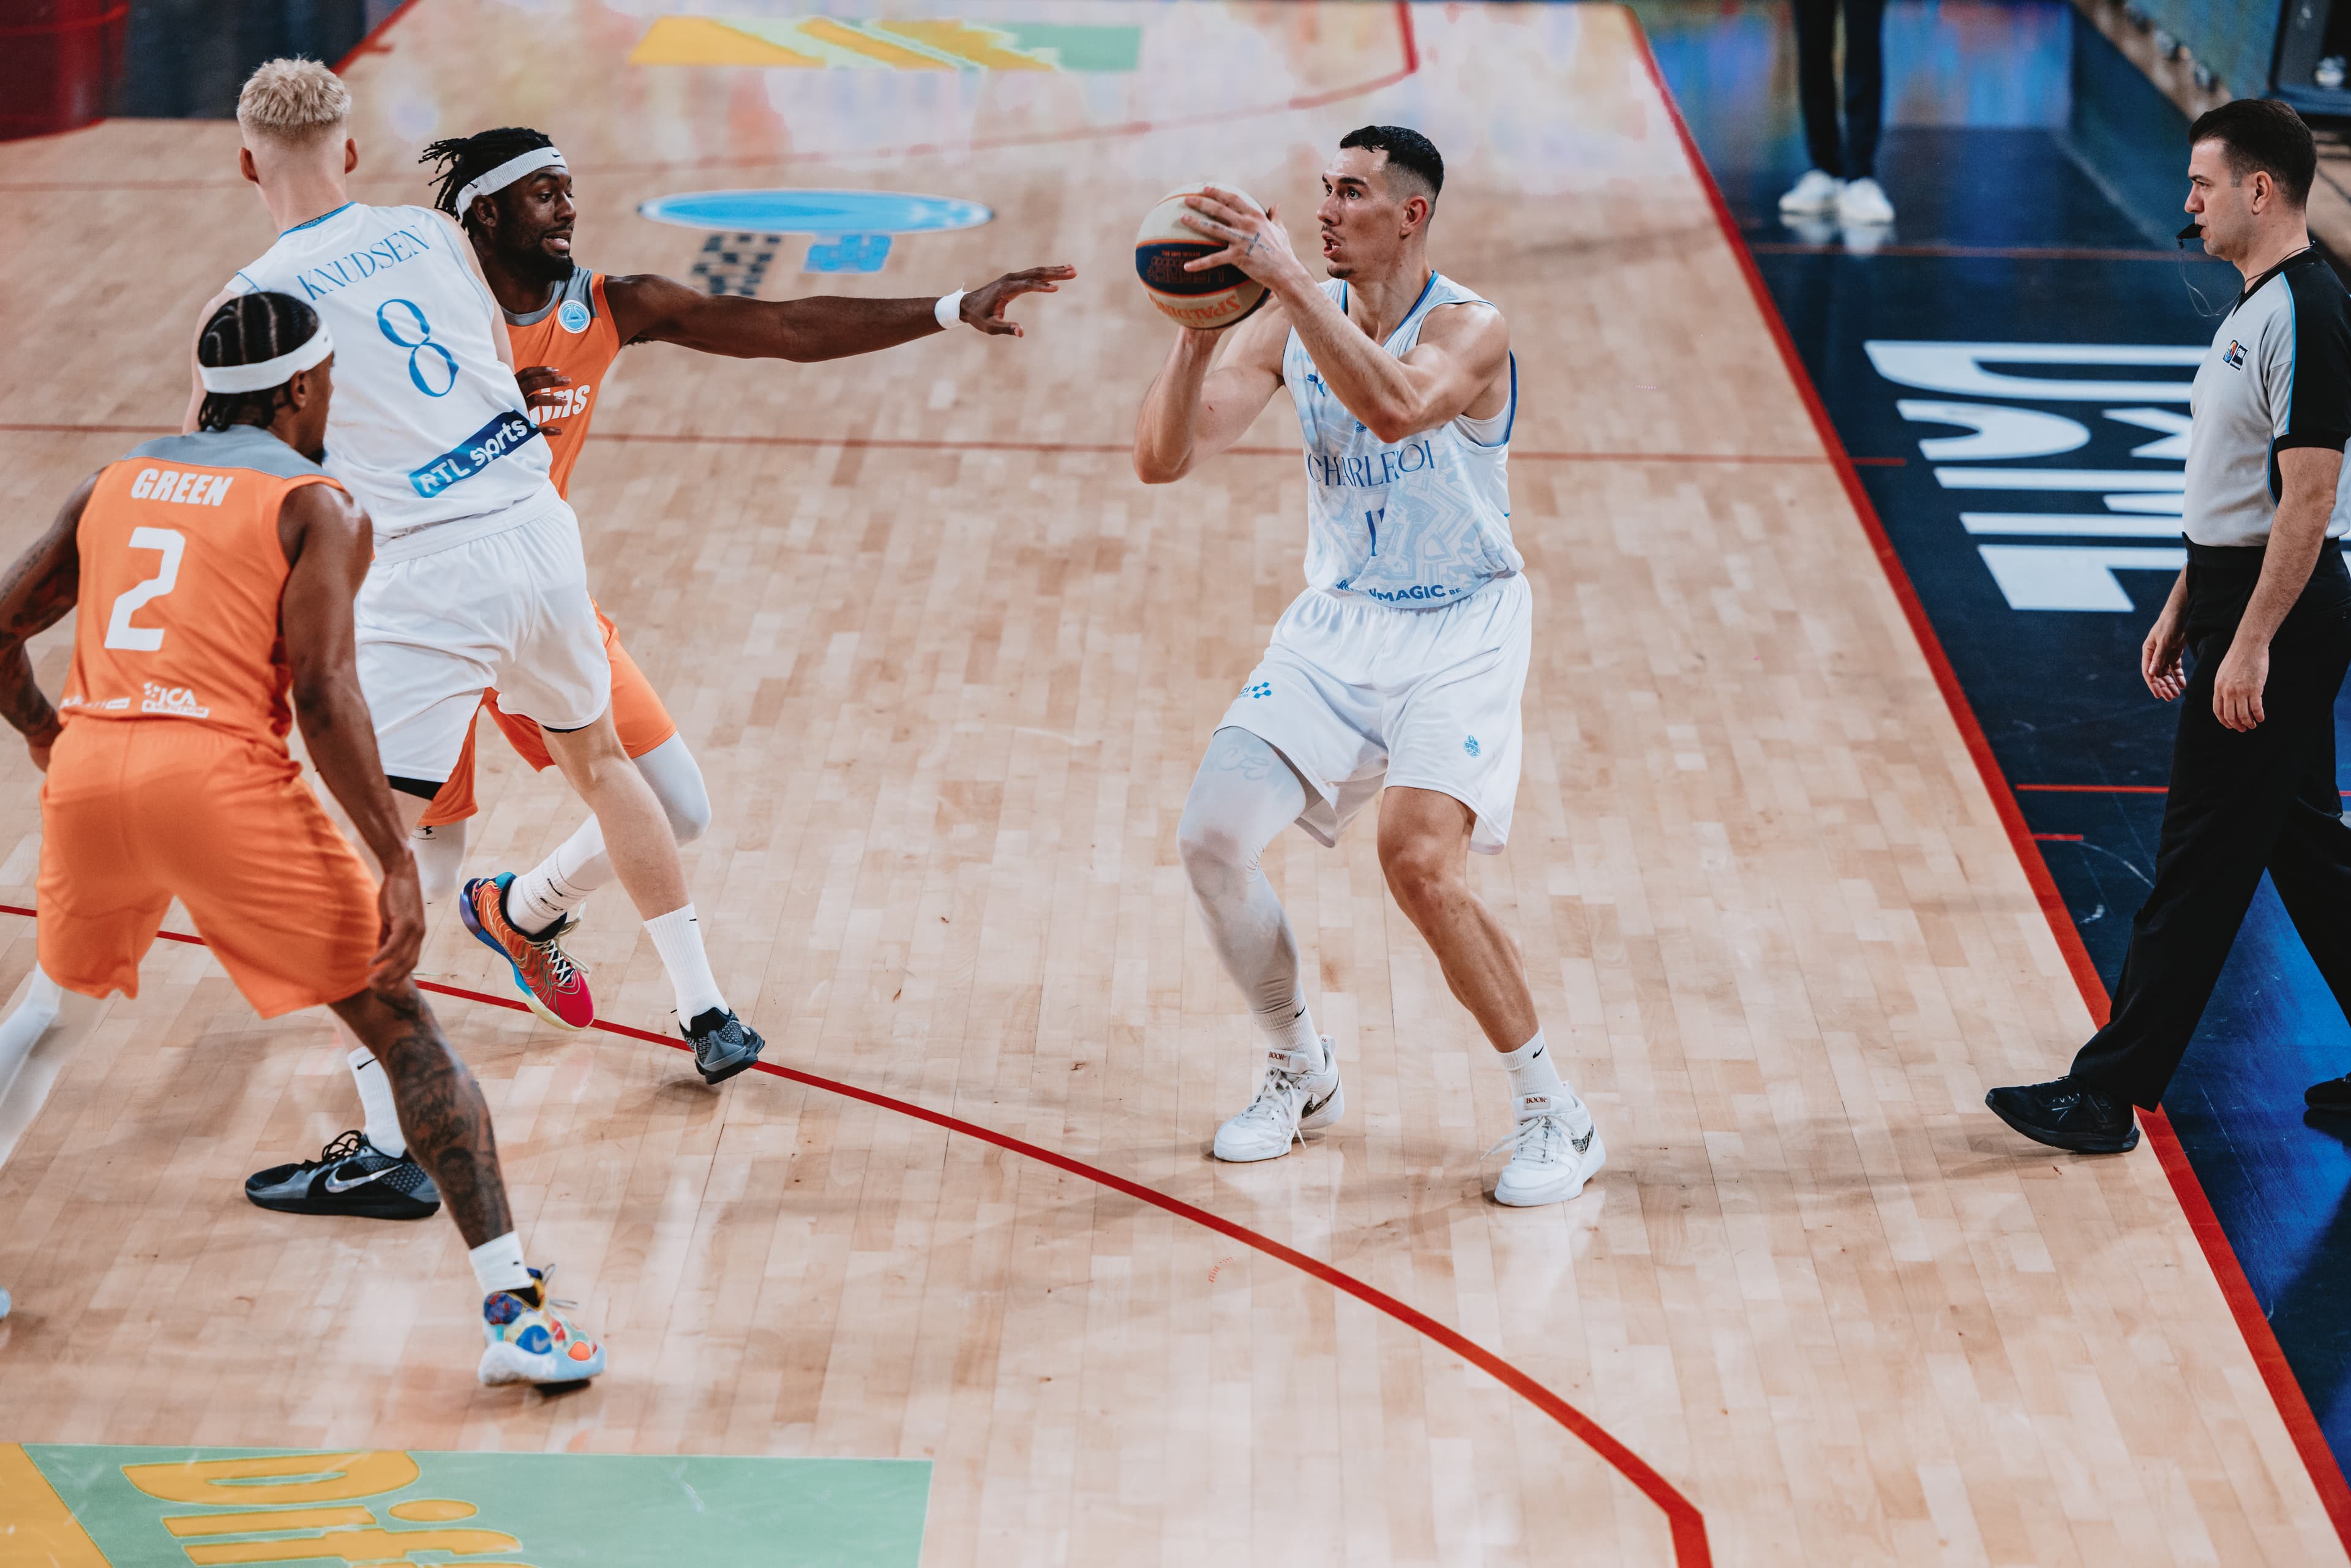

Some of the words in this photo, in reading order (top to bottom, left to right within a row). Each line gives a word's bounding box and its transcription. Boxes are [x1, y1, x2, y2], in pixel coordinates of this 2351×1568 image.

[297, 225, 430, 301] KNUDSEN
[377, 299, 459, 397] 8
[131, 468, 234, 506] GREEN
[418, 459, 470, 493] RTL
[470, 420, 528, 467] sports
[104, 527, 186, 651] 2
